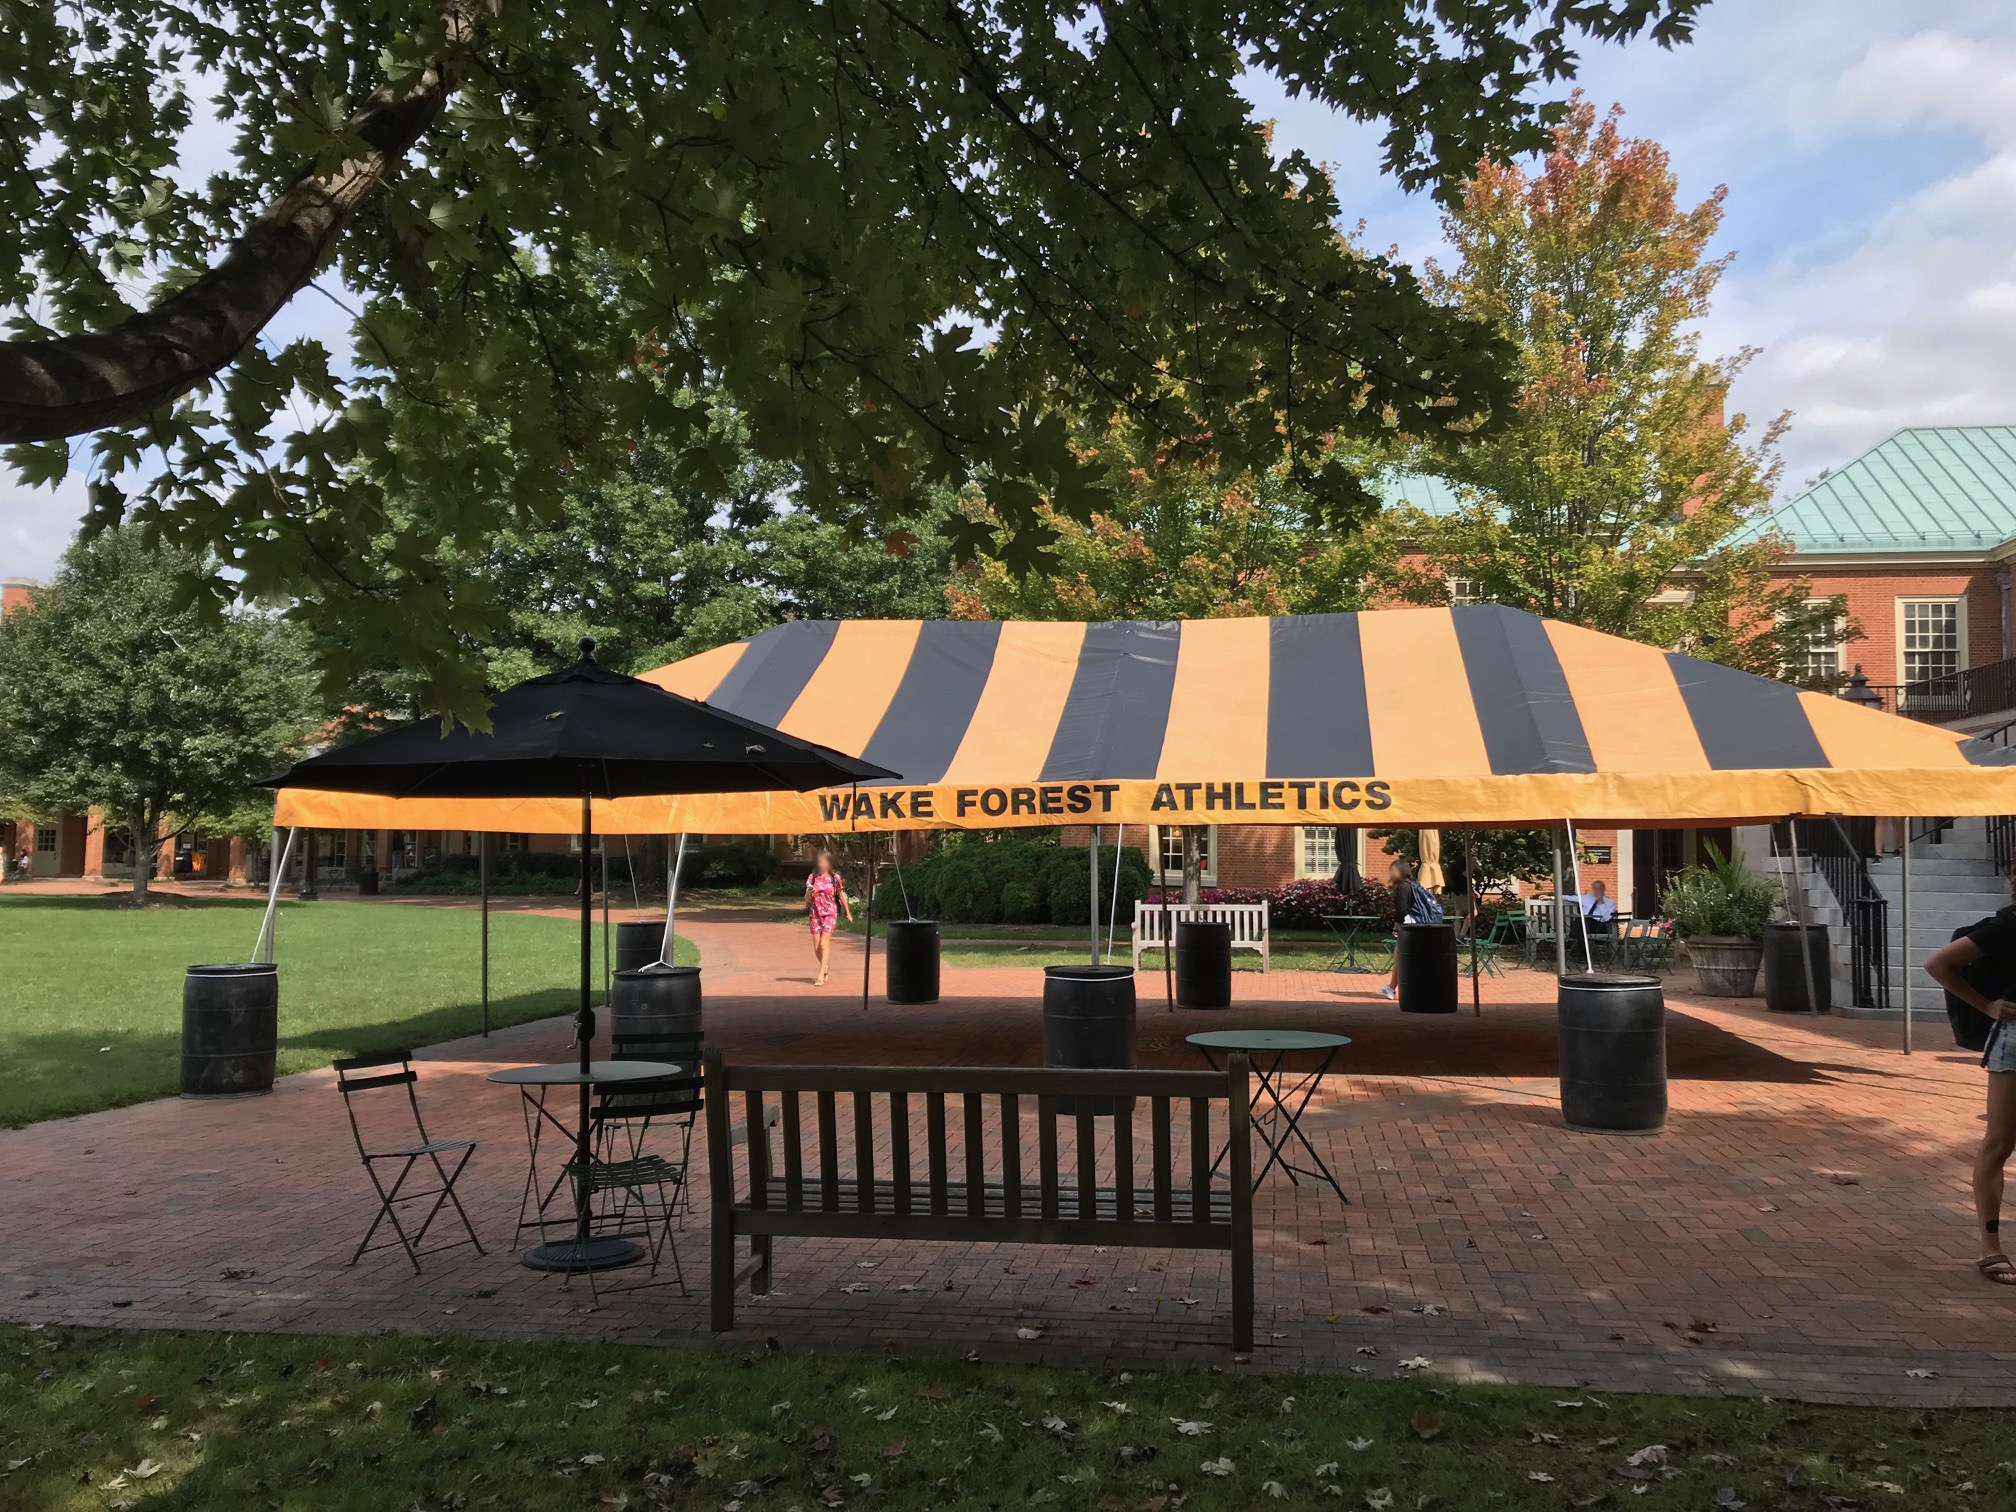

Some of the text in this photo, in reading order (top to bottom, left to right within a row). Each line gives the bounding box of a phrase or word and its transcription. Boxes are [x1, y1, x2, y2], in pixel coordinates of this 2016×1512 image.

[818, 781, 1391, 821] WAKE FOREST ATHLETICS
